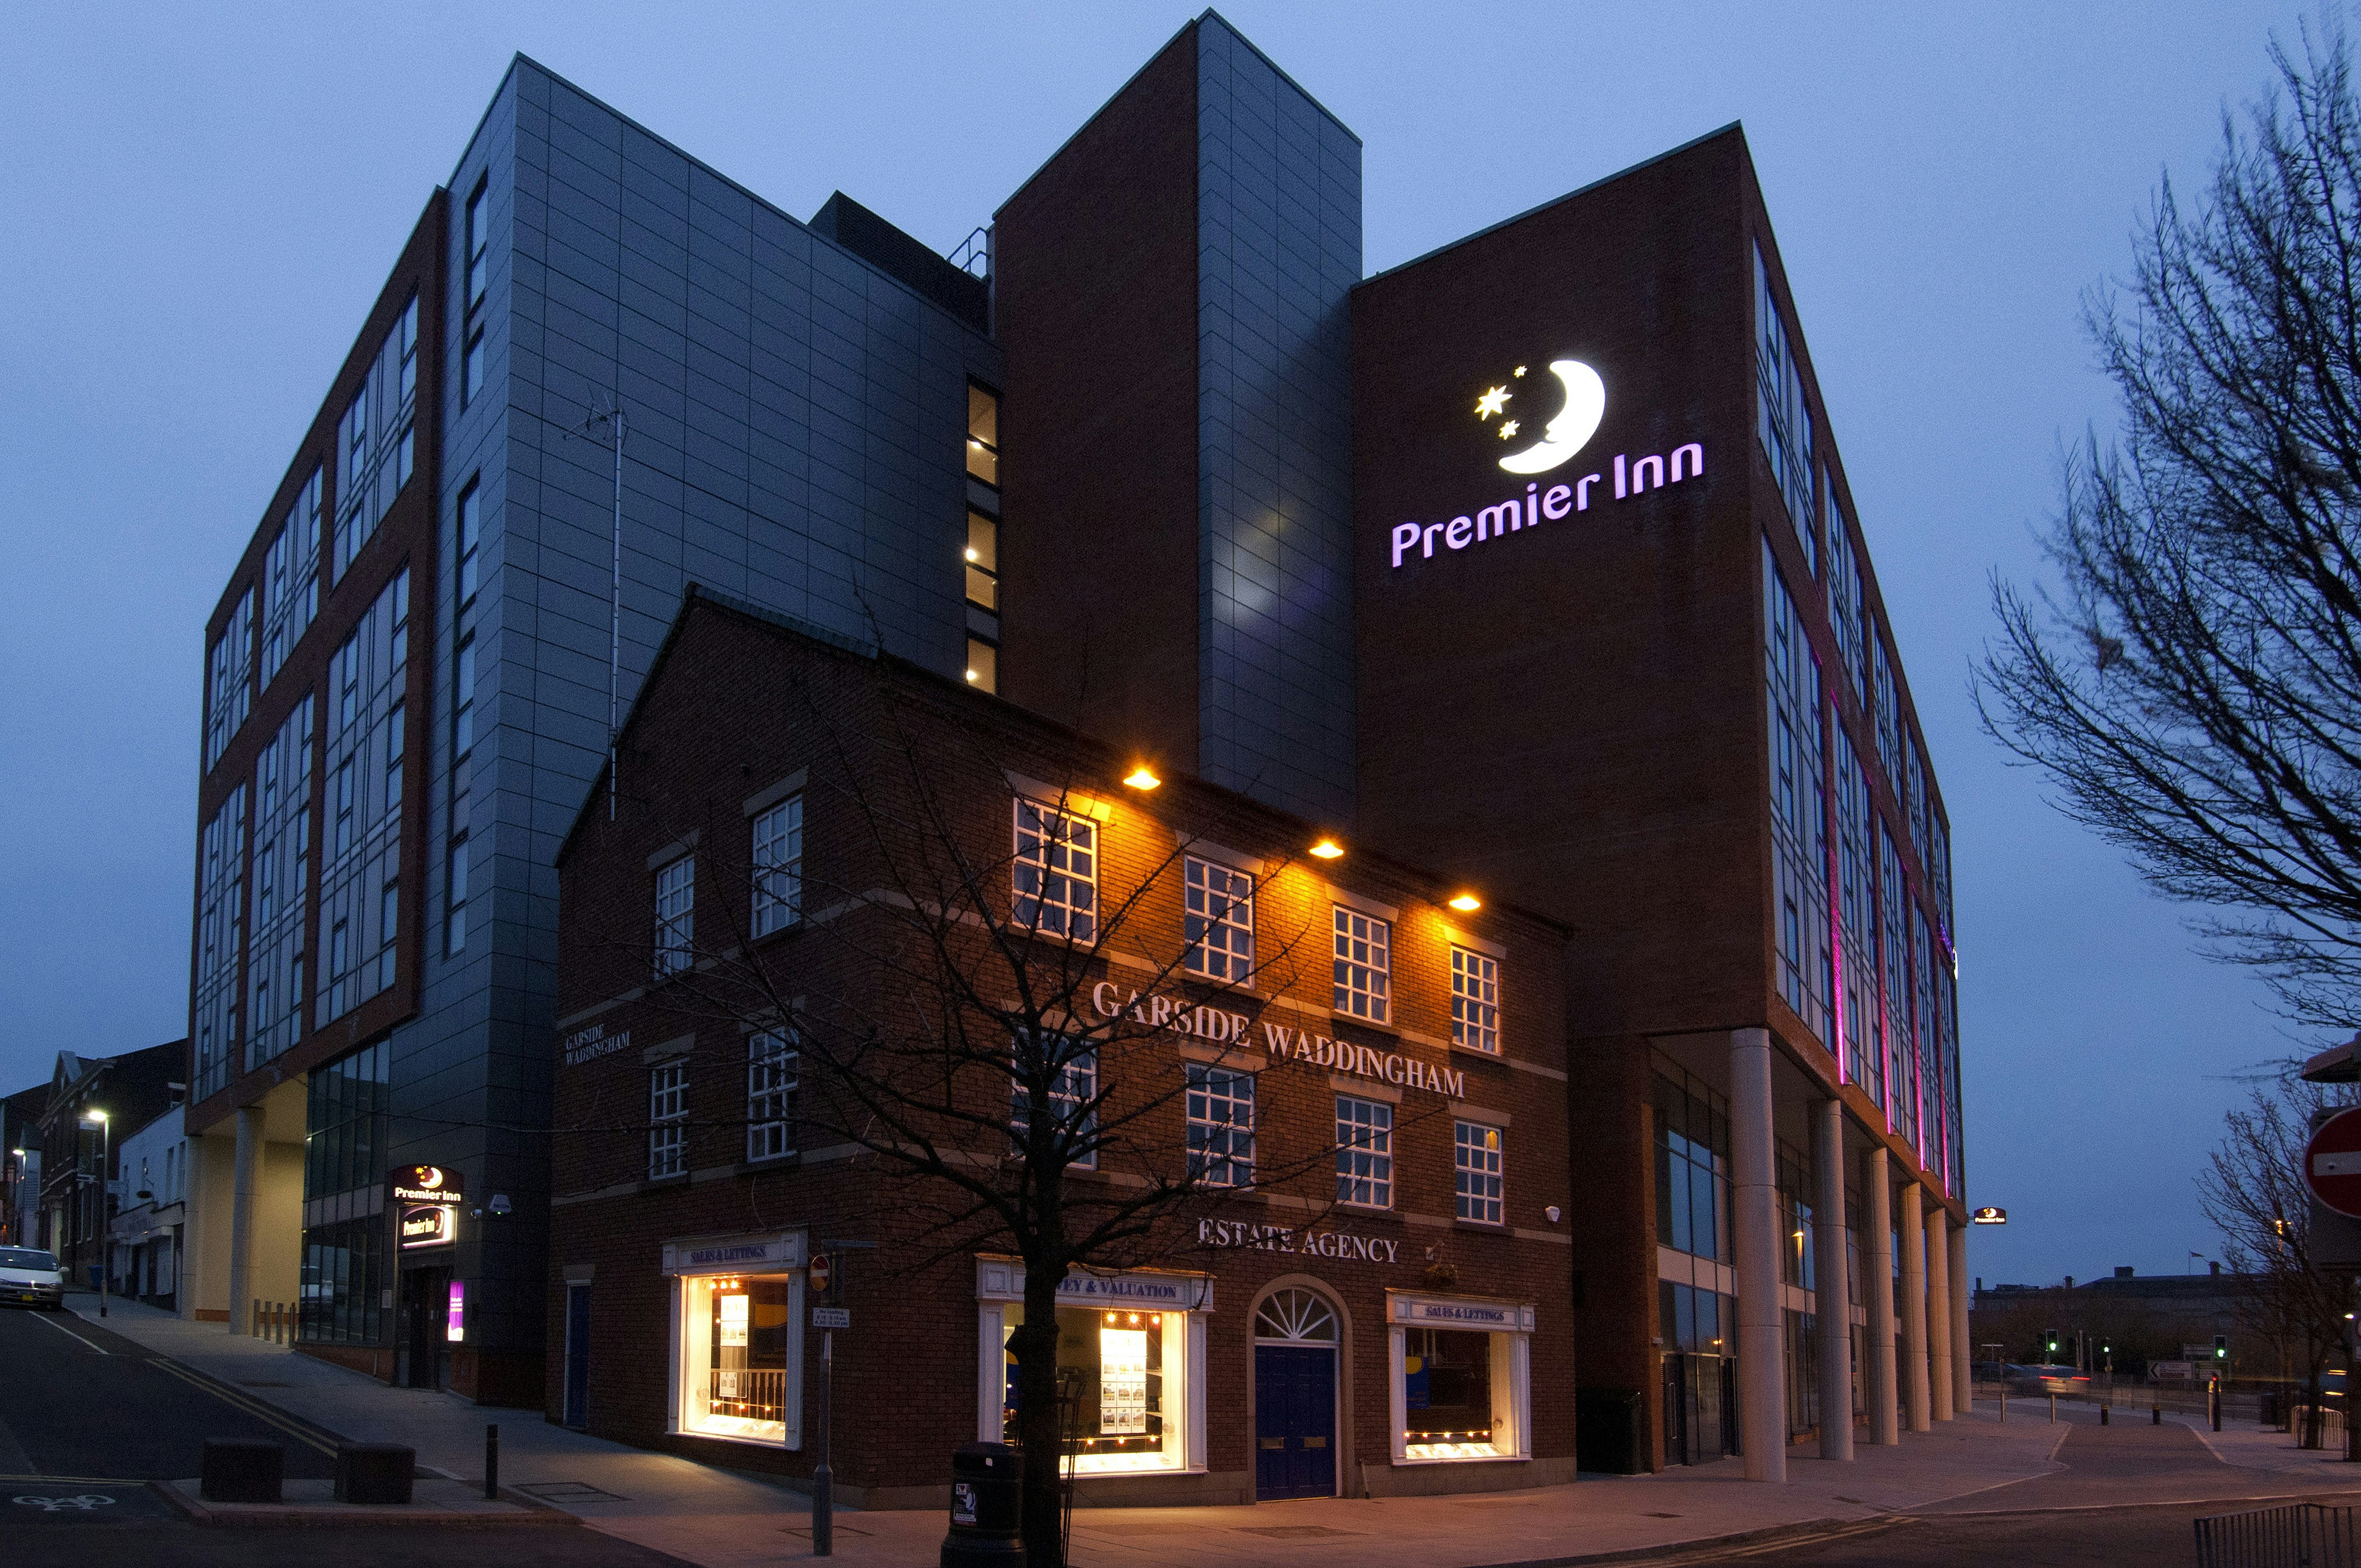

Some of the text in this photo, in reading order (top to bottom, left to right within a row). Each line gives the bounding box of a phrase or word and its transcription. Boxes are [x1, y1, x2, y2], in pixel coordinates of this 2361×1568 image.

[1392, 443, 1703, 567] Premier Inn
[566, 1023, 604, 1050] GARSIDE
[1093, 982, 1466, 1098] GARSIDE WADDINGHAM
[395, 1187, 461, 1201] Premier Inn
[403, 1217, 435, 1236] Premier Inn
[1198, 1218, 1399, 1263] ESTATE AGENCY
[1086, 1280, 1097, 1293] &
[1101, 1281, 1176, 1297] VALUATION
